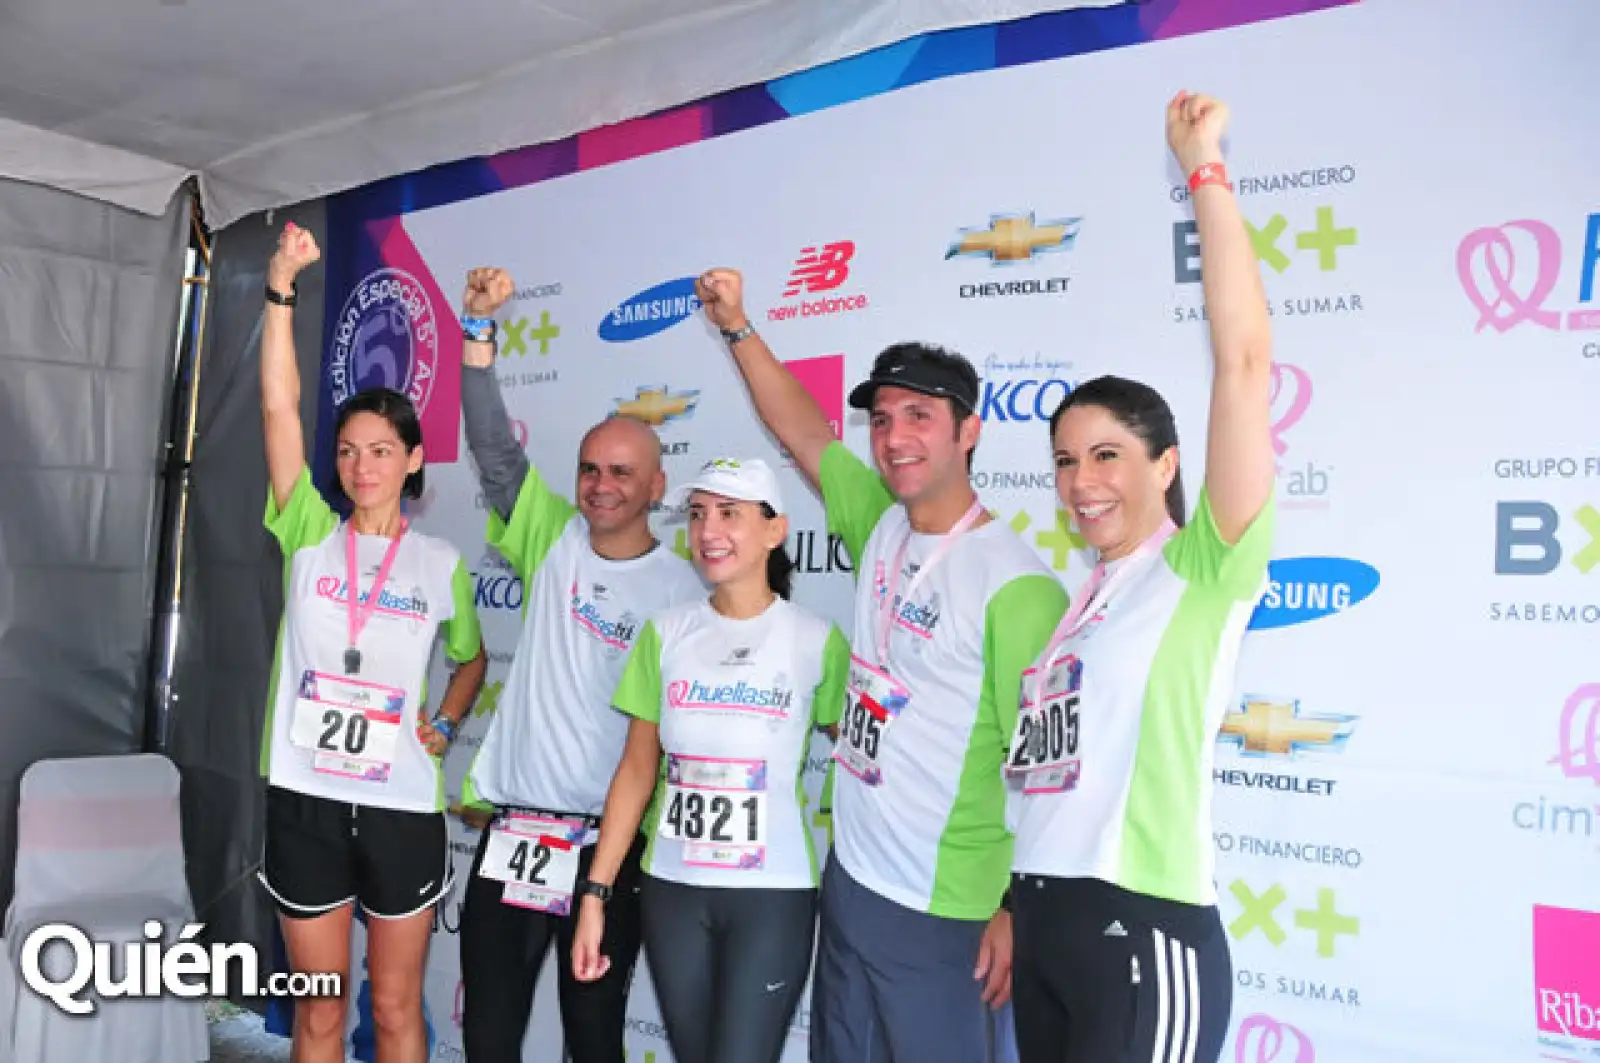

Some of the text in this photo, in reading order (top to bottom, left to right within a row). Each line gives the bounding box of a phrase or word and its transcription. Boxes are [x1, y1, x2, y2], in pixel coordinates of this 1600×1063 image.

[1239, 165, 1356, 195] FINANCIERO
[959, 277, 1071, 299] CHEVROLET
[1284, 294, 1364, 316] SUMAR
[1494, 457, 1578, 478] GRUPO
[317, 709, 369, 754] 20
[667, 792, 759, 842] 4321
[507, 839, 551, 886] 42
[1277, 976, 1361, 1006] SUMAR
